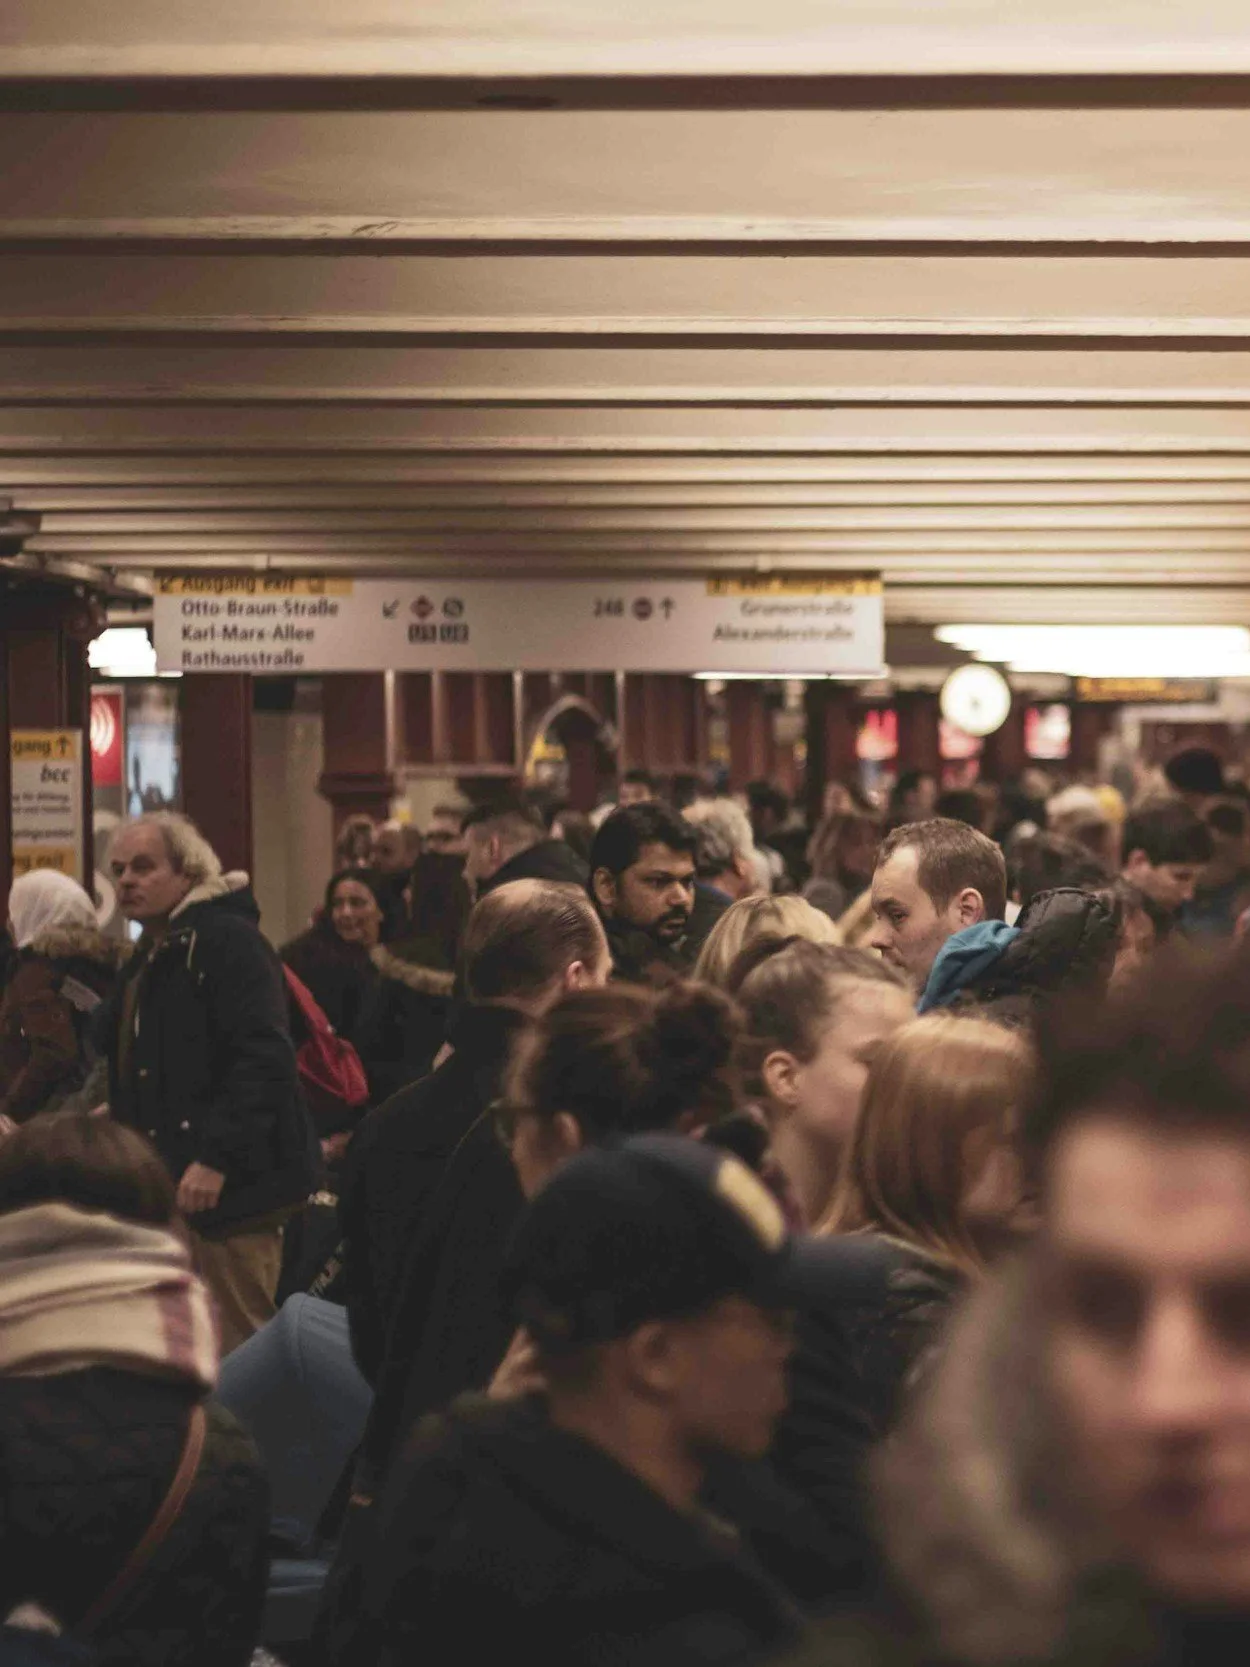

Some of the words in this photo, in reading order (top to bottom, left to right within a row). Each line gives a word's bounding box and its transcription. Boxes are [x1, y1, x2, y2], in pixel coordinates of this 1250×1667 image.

[181, 598, 339, 618] Otto-Braun-Straße
[181, 623, 315, 642] Karl-Marx-Allee
[181, 649, 305, 667] Rathausstraße
